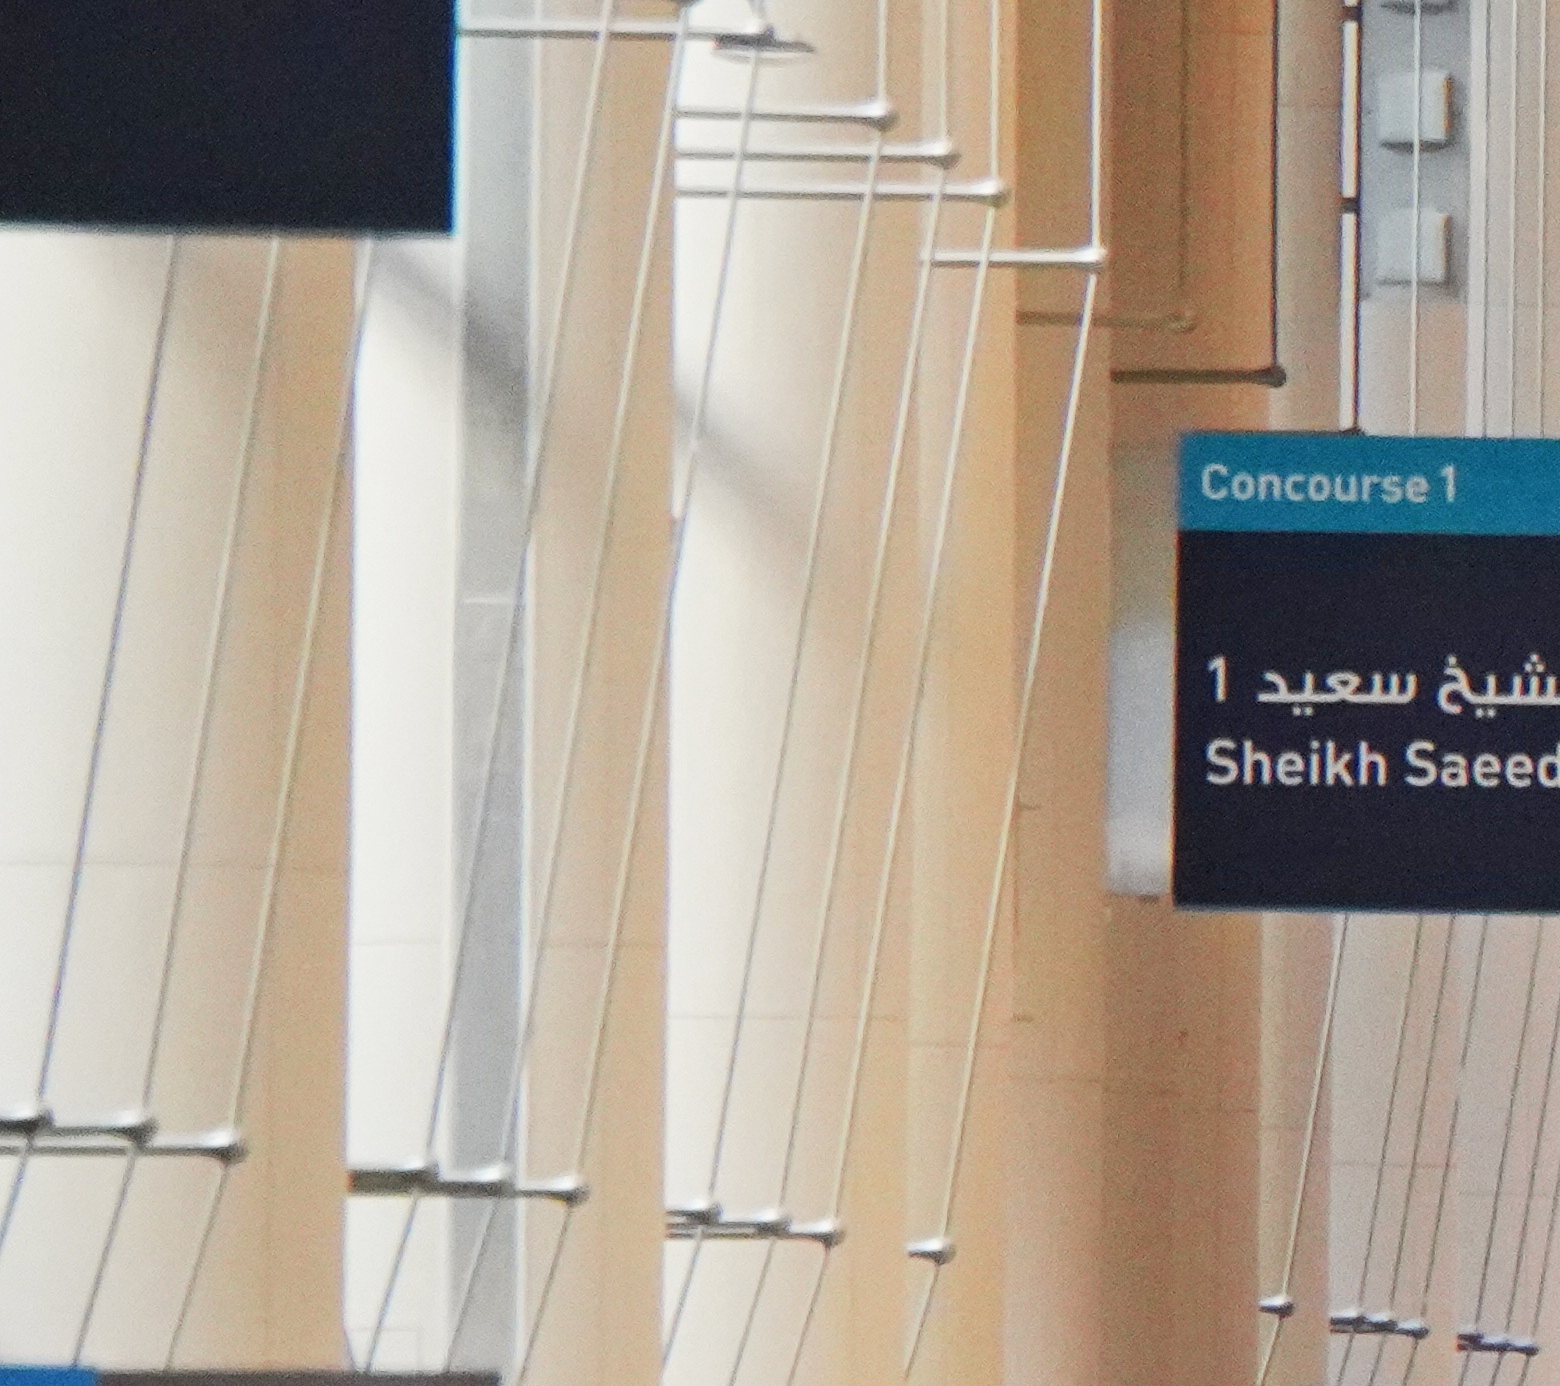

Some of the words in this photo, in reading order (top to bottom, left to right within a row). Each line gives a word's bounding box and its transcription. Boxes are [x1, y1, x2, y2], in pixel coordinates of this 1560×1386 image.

[1202, 464, 1430, 505] Concourse
[1441, 466, 1457, 504] 1
[1206, 656, 1229, 703] 1
[1256, 668, 1418, 717] سعيد
[1205, 739, 1388, 787] Sheikh
